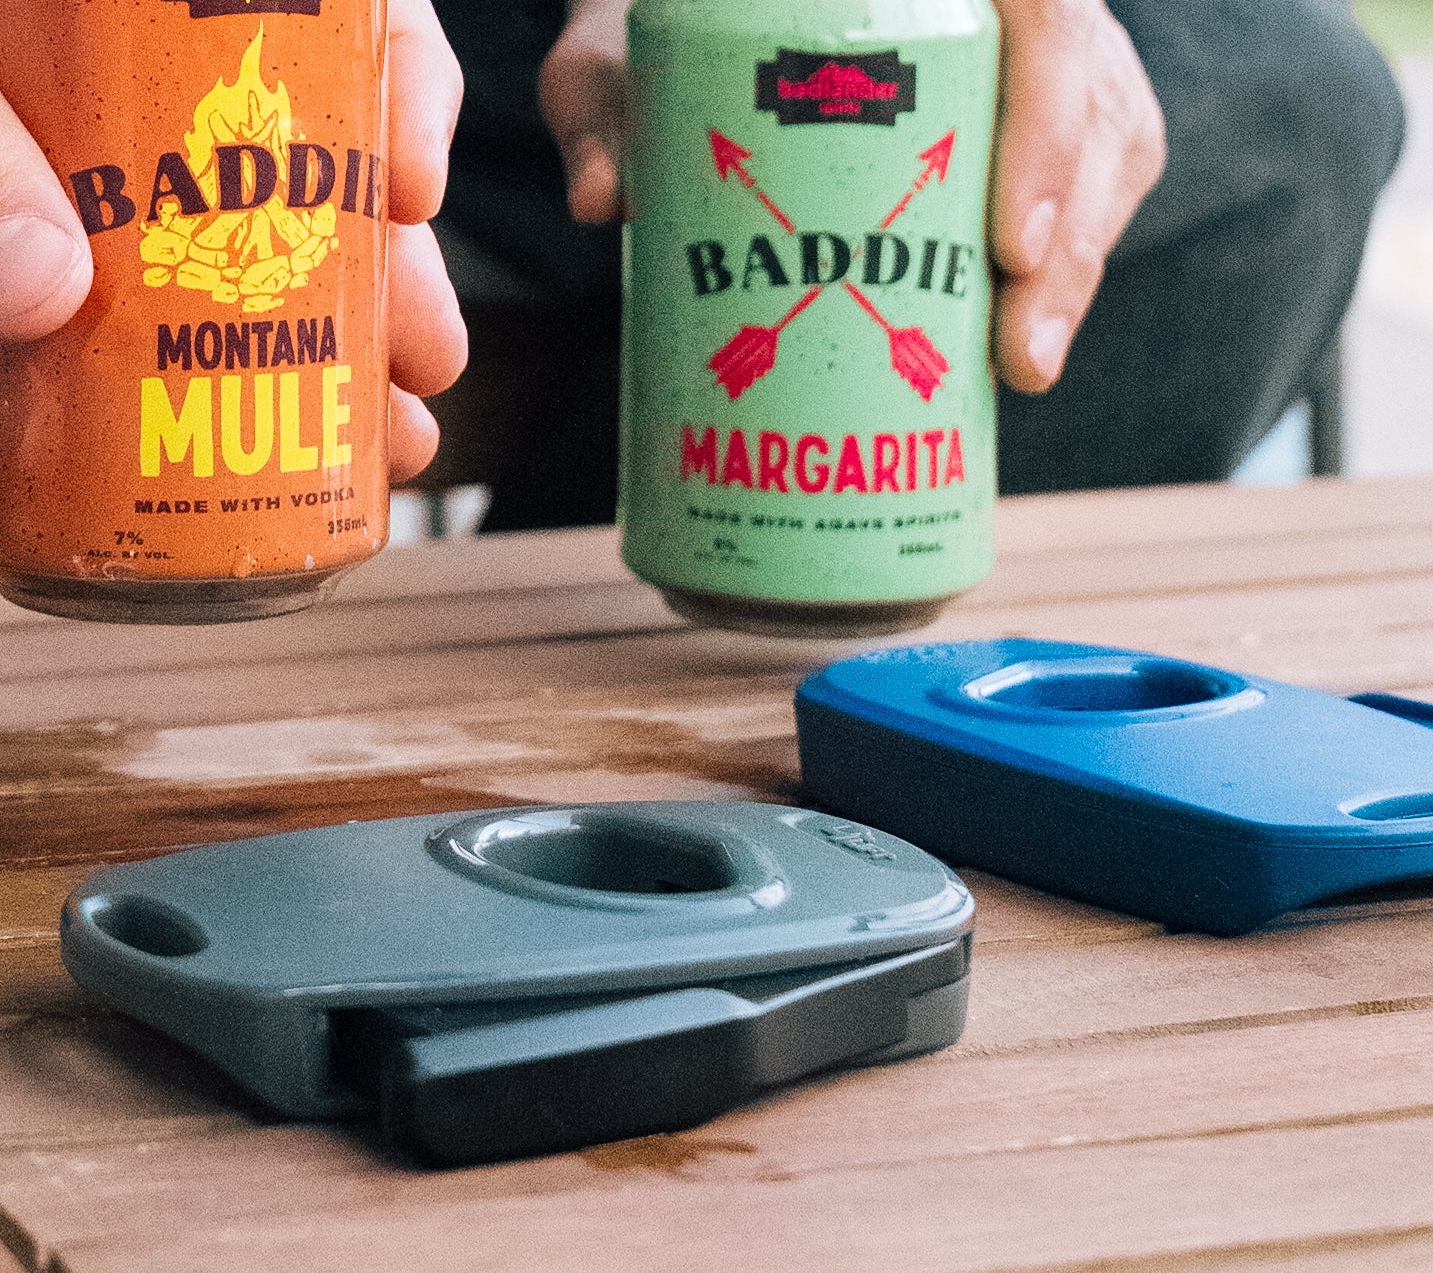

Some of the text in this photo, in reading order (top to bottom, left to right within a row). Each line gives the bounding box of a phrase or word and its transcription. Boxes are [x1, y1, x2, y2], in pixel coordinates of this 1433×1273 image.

[69, 141, 383, 236] BADDIE
[685, 229, 977, 300] BADDIE
[156, 314, 338, 371] MONTANA
[139, 364, 353, 479] MULE
[680, 426, 967, 495] MARGARITA
[134, 486, 355, 514] MADE WITH VODKA
[114, 530, 144, 546] 7%
